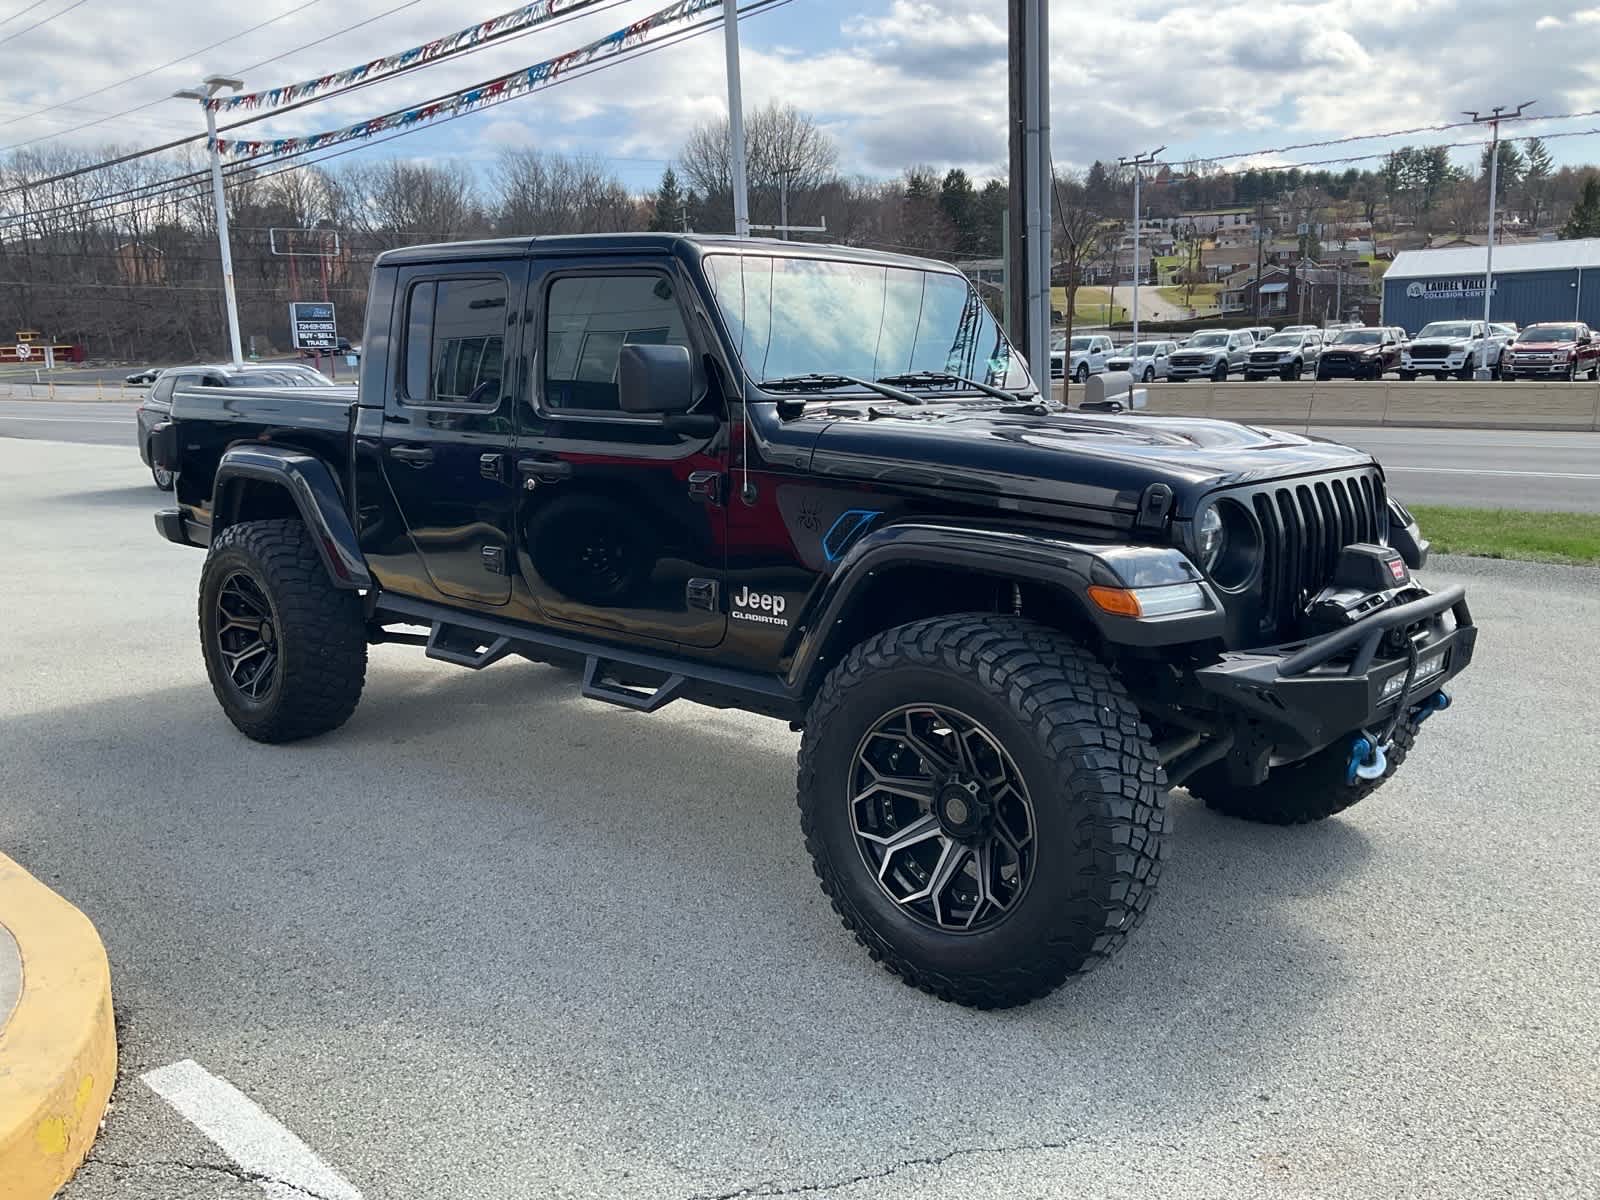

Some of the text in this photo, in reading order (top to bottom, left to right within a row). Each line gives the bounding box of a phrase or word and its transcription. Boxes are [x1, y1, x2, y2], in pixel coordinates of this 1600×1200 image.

[1461, 279, 1496, 290] VALLY
[1424, 291, 1463, 299] COLLISION
[735, 585, 786, 616] Jeep
[731, 610, 789, 627] GLADIATOR
